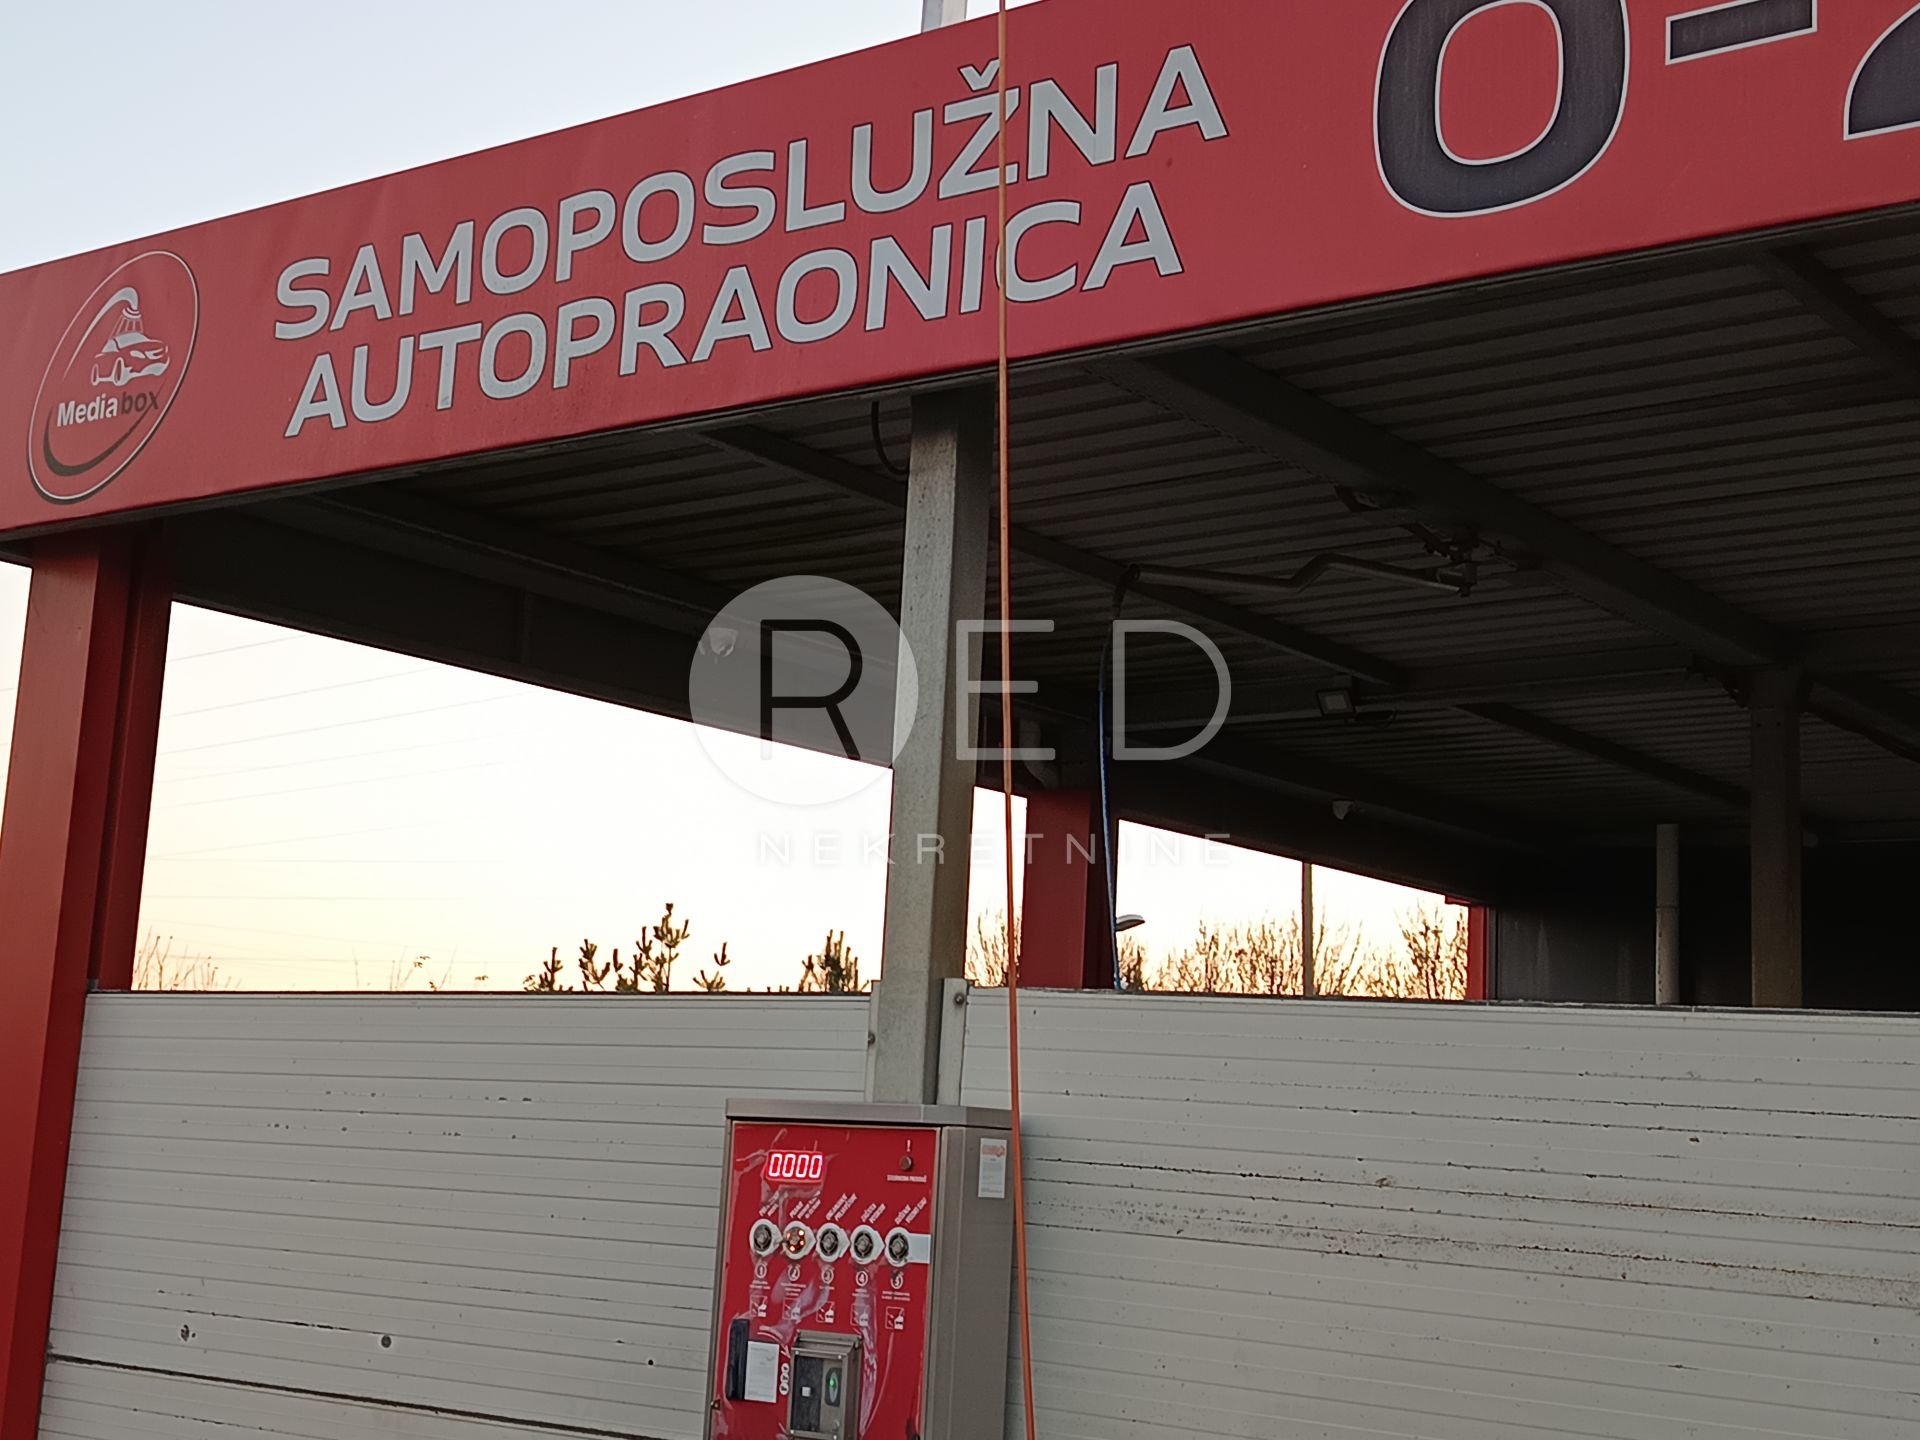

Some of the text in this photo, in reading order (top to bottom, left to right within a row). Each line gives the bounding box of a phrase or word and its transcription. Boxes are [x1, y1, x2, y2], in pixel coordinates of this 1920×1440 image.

[274, 43, 1229, 341] SAMOPOSLUŽNA
[284, 180, 1184, 438] AUTOPRAONICA
[768, 1153, 823, 1179] 0000
